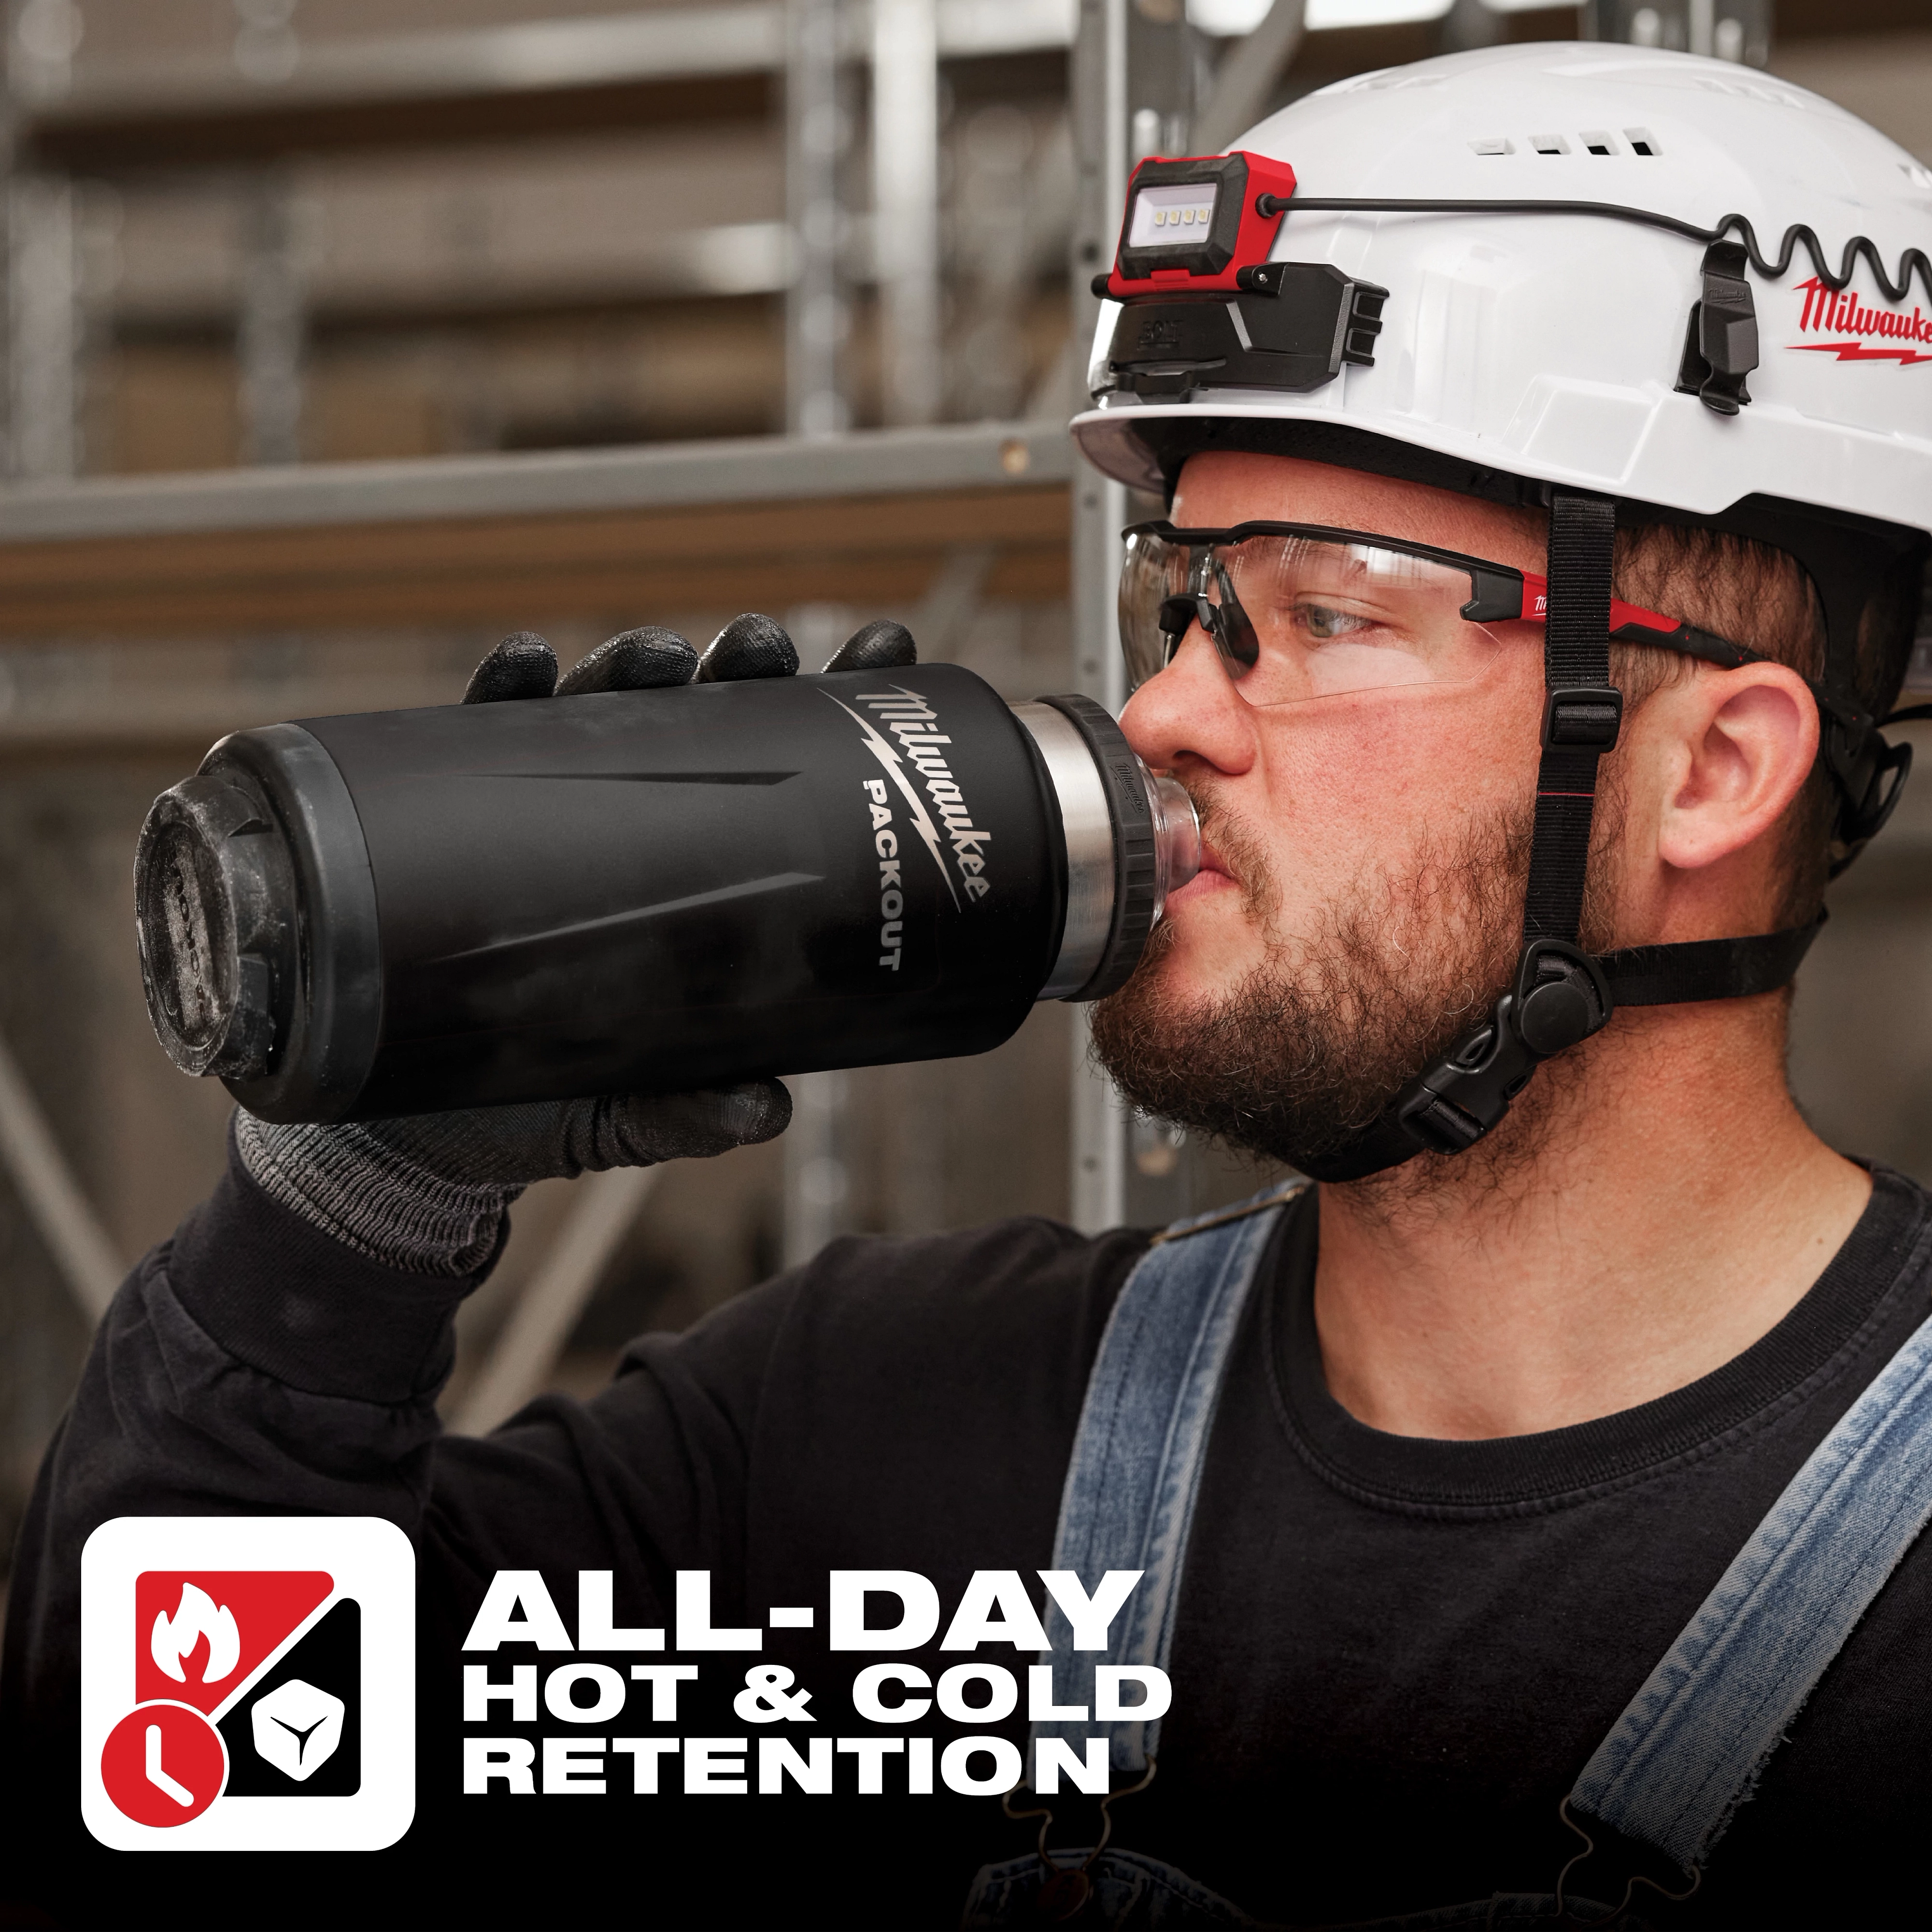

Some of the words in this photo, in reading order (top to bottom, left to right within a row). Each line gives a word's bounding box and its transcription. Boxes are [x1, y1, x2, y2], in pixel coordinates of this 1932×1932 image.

[855, 684, 992, 903] Milwaukee
[863, 780, 904, 971] PACKOUT
[1115, 763, 1144, 813] Milwaukee
